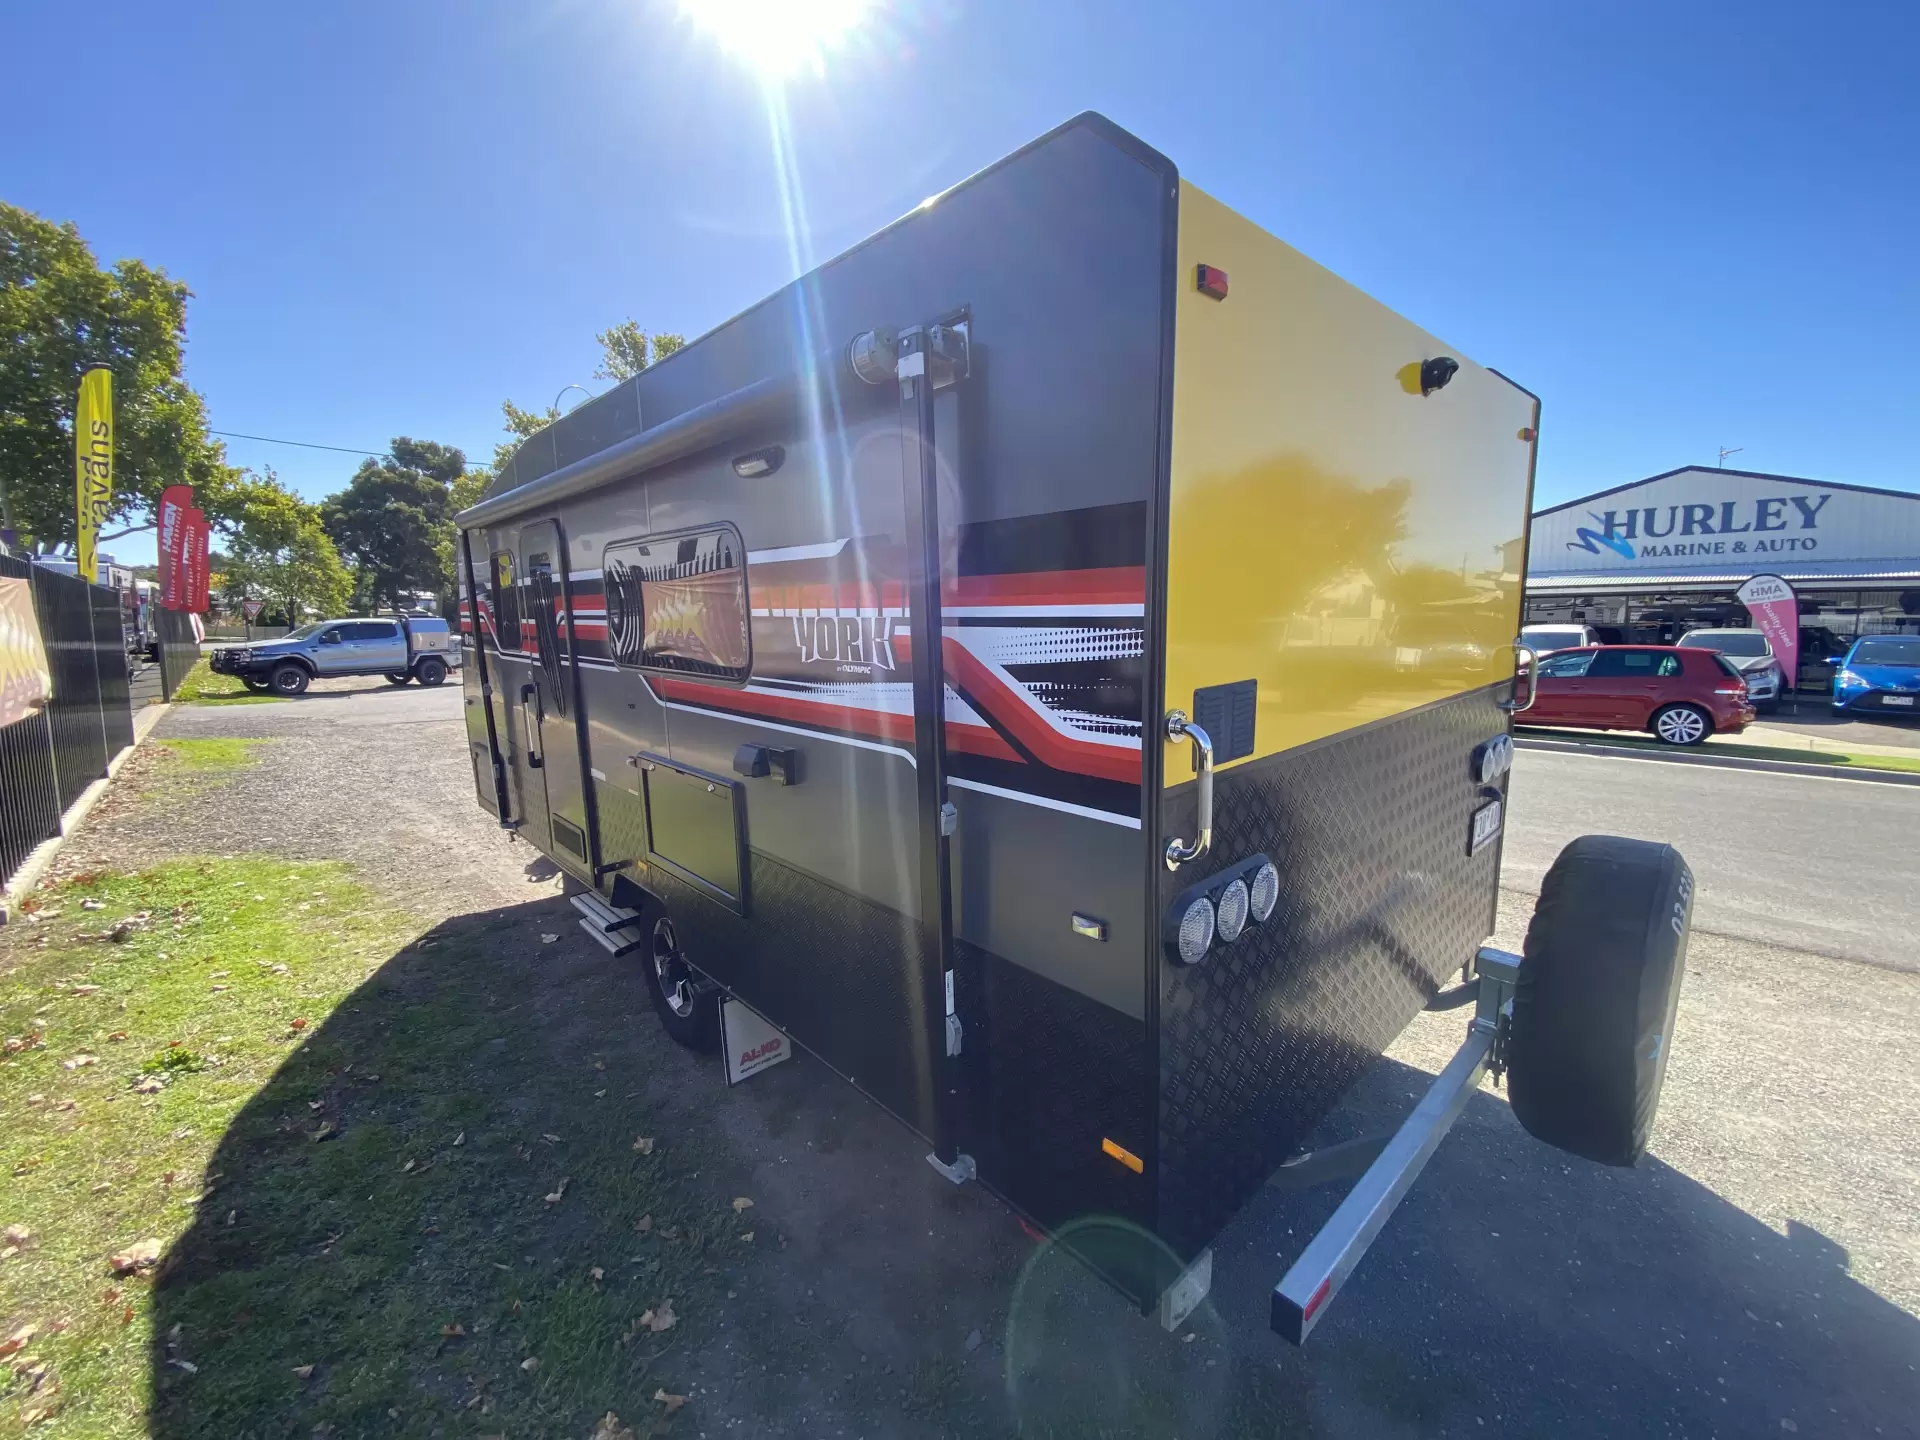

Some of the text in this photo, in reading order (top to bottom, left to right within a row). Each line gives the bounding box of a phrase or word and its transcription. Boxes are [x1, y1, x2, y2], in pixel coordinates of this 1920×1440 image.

[162, 501, 177, 553] HAVEN
[1603, 494, 1832, 541] HURLEY
[1640, 537, 1818, 558] MARINE & AUTO
[1750, 584, 1783, 598] HMA
[1762, 602, 1781, 629] Quality
[1778, 626, 1794, 648] Used
[793, 616, 896, 671] YORK
[842, 664, 872, 675] OLYMPIC
[1671, 902, 1686, 936] 03
[740, 1038, 781, 1066] AL-KO
